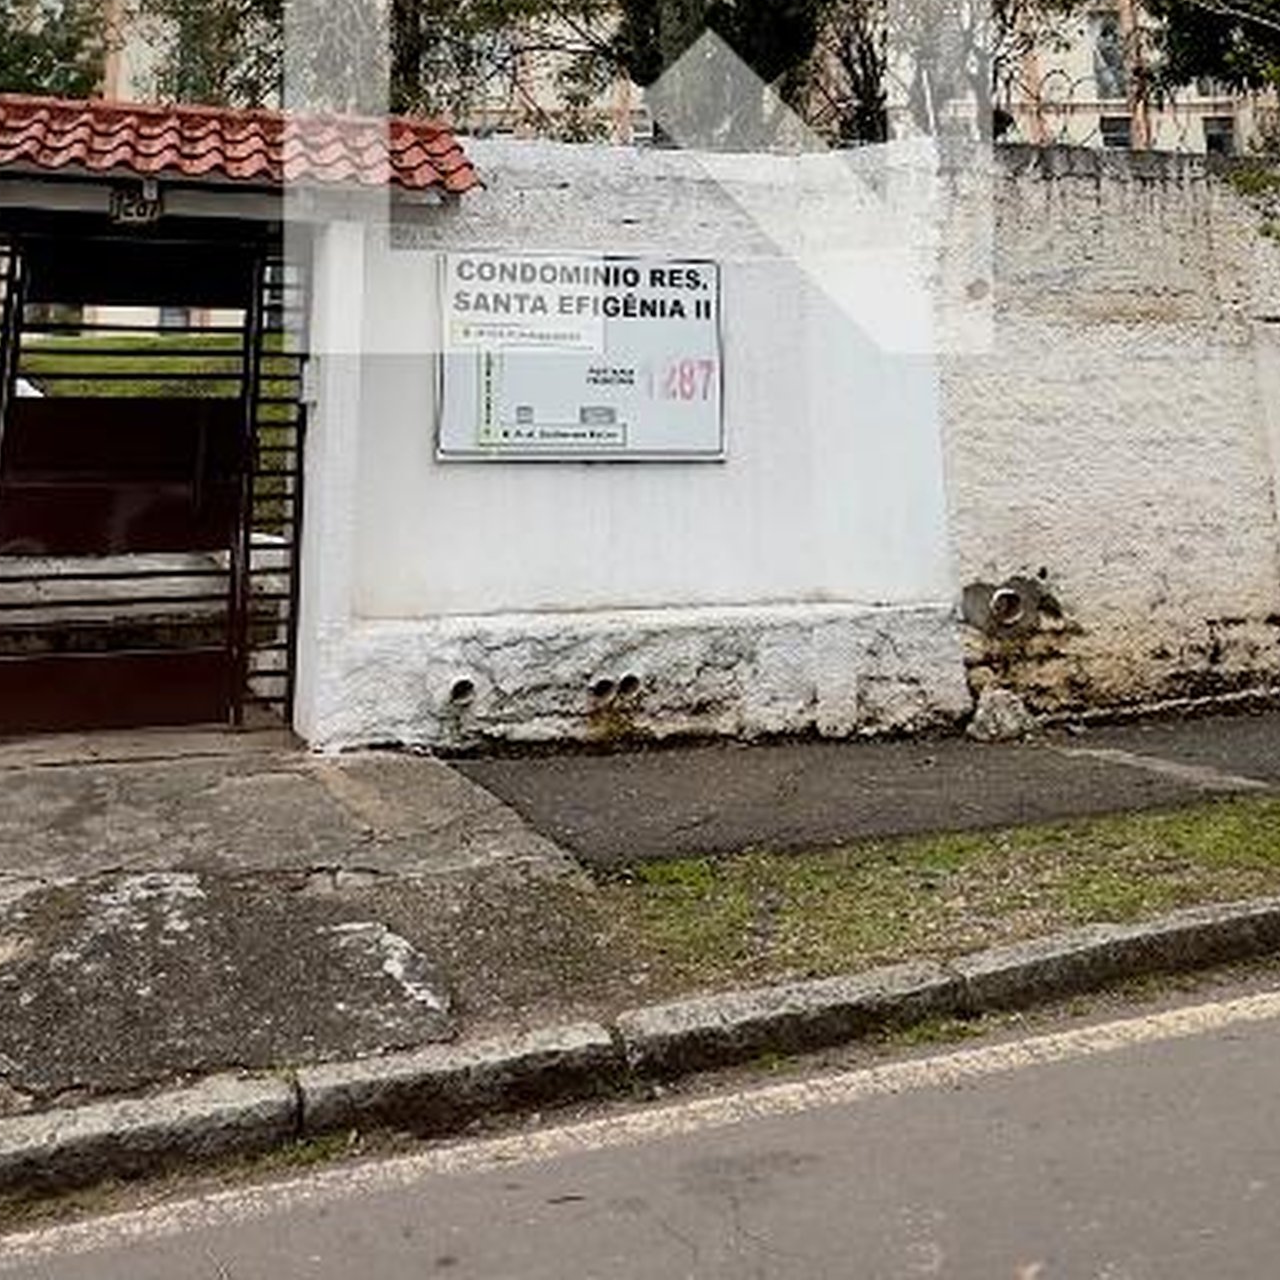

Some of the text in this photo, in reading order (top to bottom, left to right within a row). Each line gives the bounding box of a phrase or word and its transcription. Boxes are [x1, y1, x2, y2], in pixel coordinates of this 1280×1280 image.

[456, 259, 709, 290] CONDOMINIO RES.
[453, 291, 712, 319] SANTA EFIGÊNIA II
